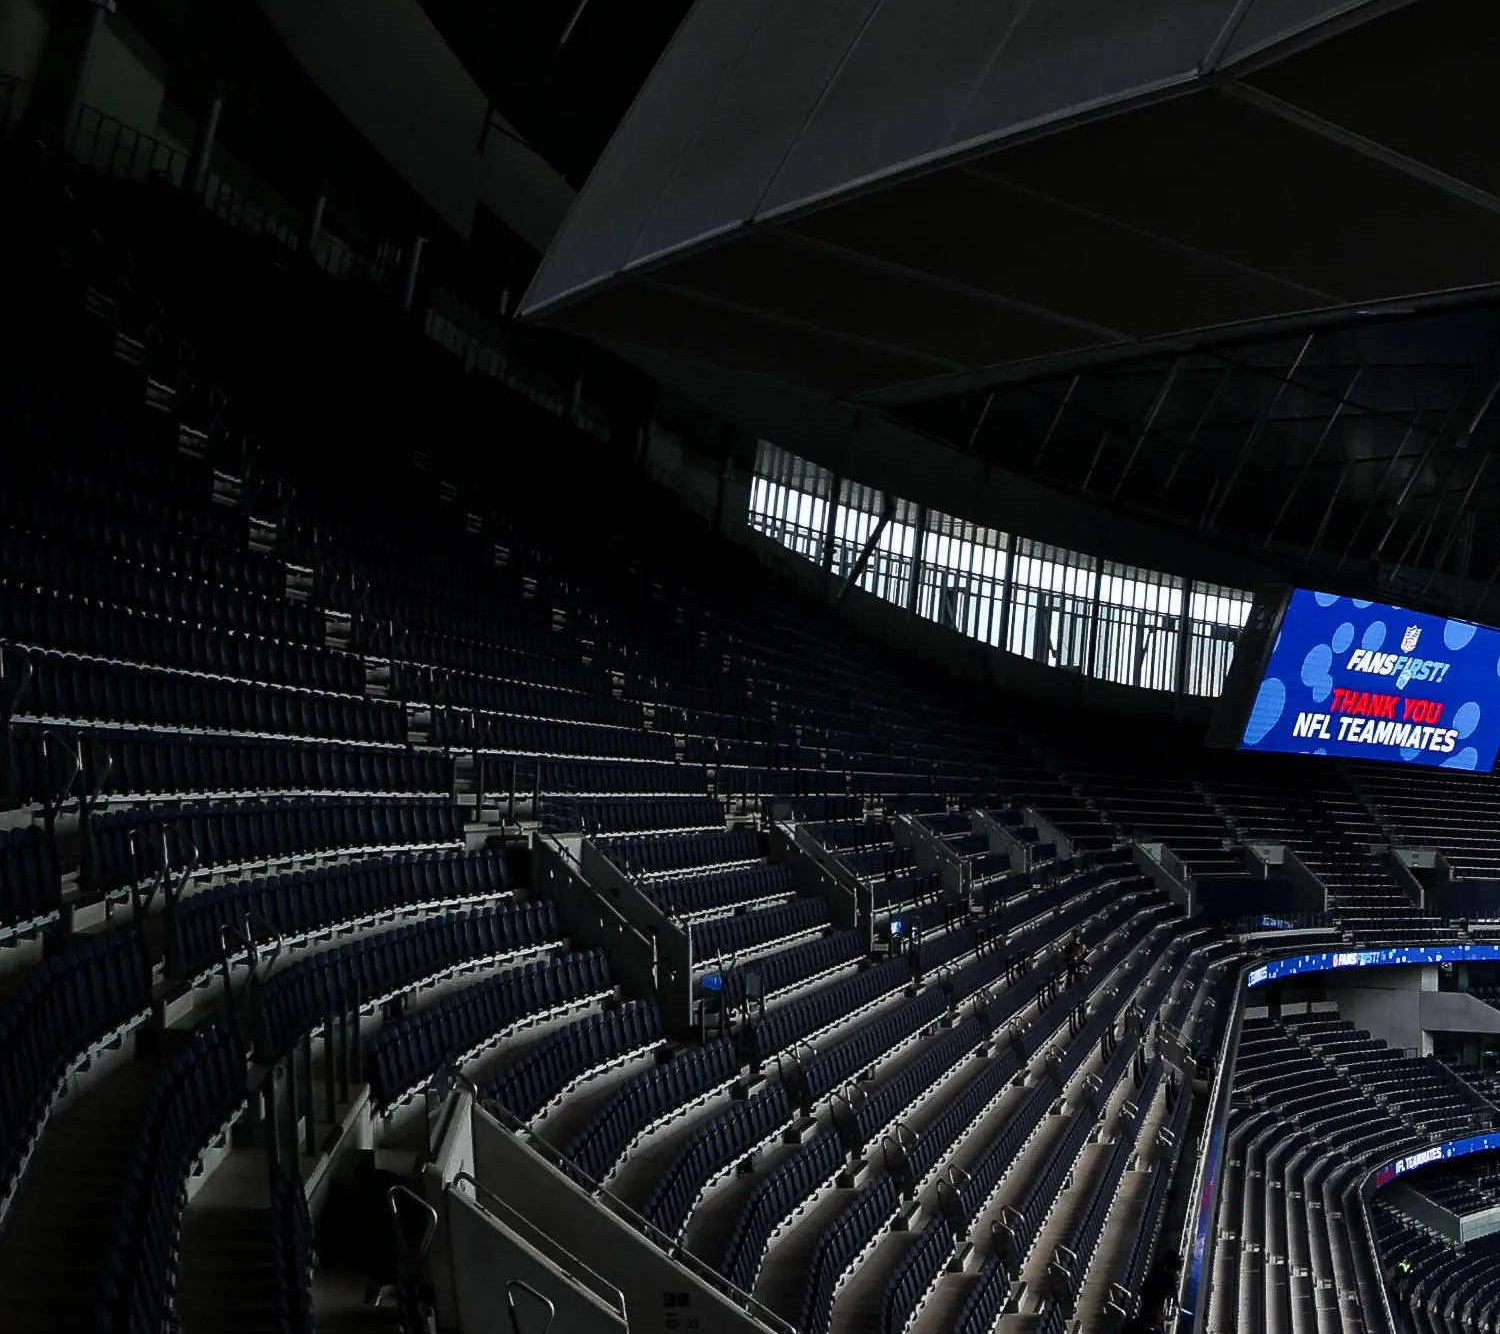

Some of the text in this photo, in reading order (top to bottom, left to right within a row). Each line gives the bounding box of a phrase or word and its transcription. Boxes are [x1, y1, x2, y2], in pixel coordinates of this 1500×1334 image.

[1331, 688, 1445, 724] THANK YOU
[1293, 712, 1459, 753] NFL TEAMMATES
